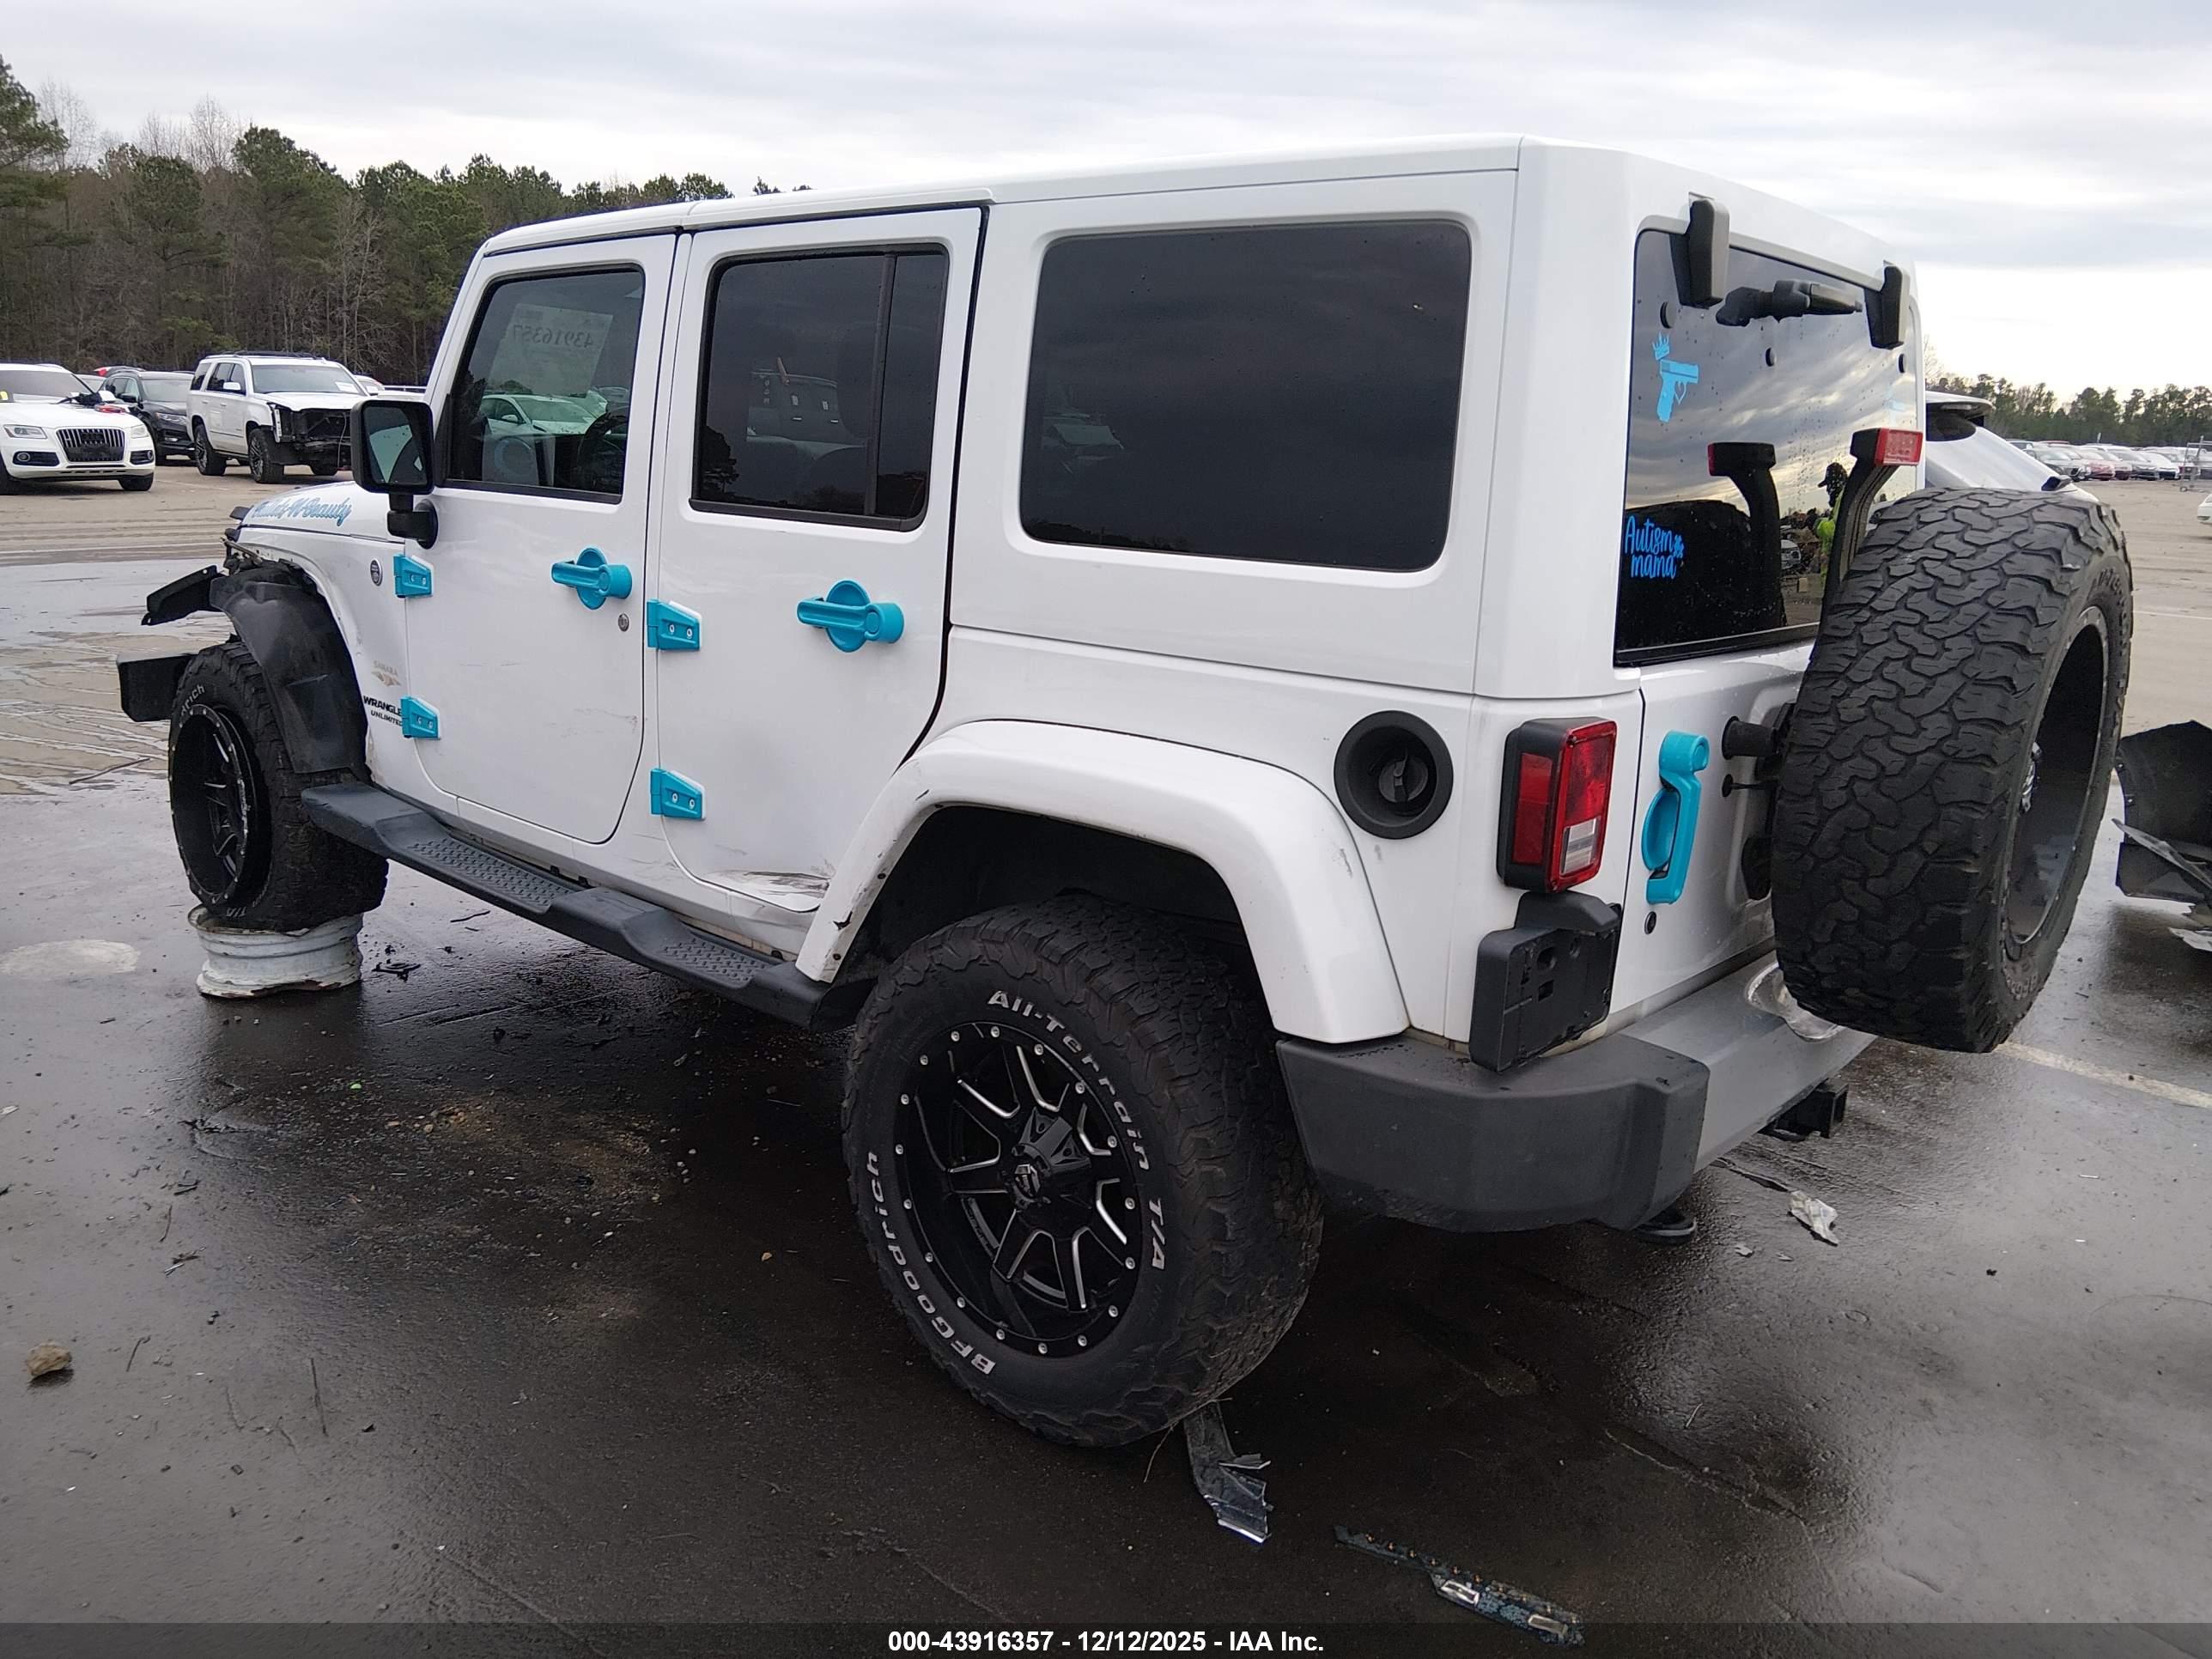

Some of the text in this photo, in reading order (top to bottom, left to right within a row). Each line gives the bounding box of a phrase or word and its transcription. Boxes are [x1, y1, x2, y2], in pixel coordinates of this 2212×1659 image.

[1625, 515, 1674, 555] Autism
[1631, 554, 1677, 580] mama
[363, 696, 402, 717] WRANGLE
[988, 990, 1166, 1271] All-Terrain T/A
[866, 1152, 996, 1375] BFGoodrich
